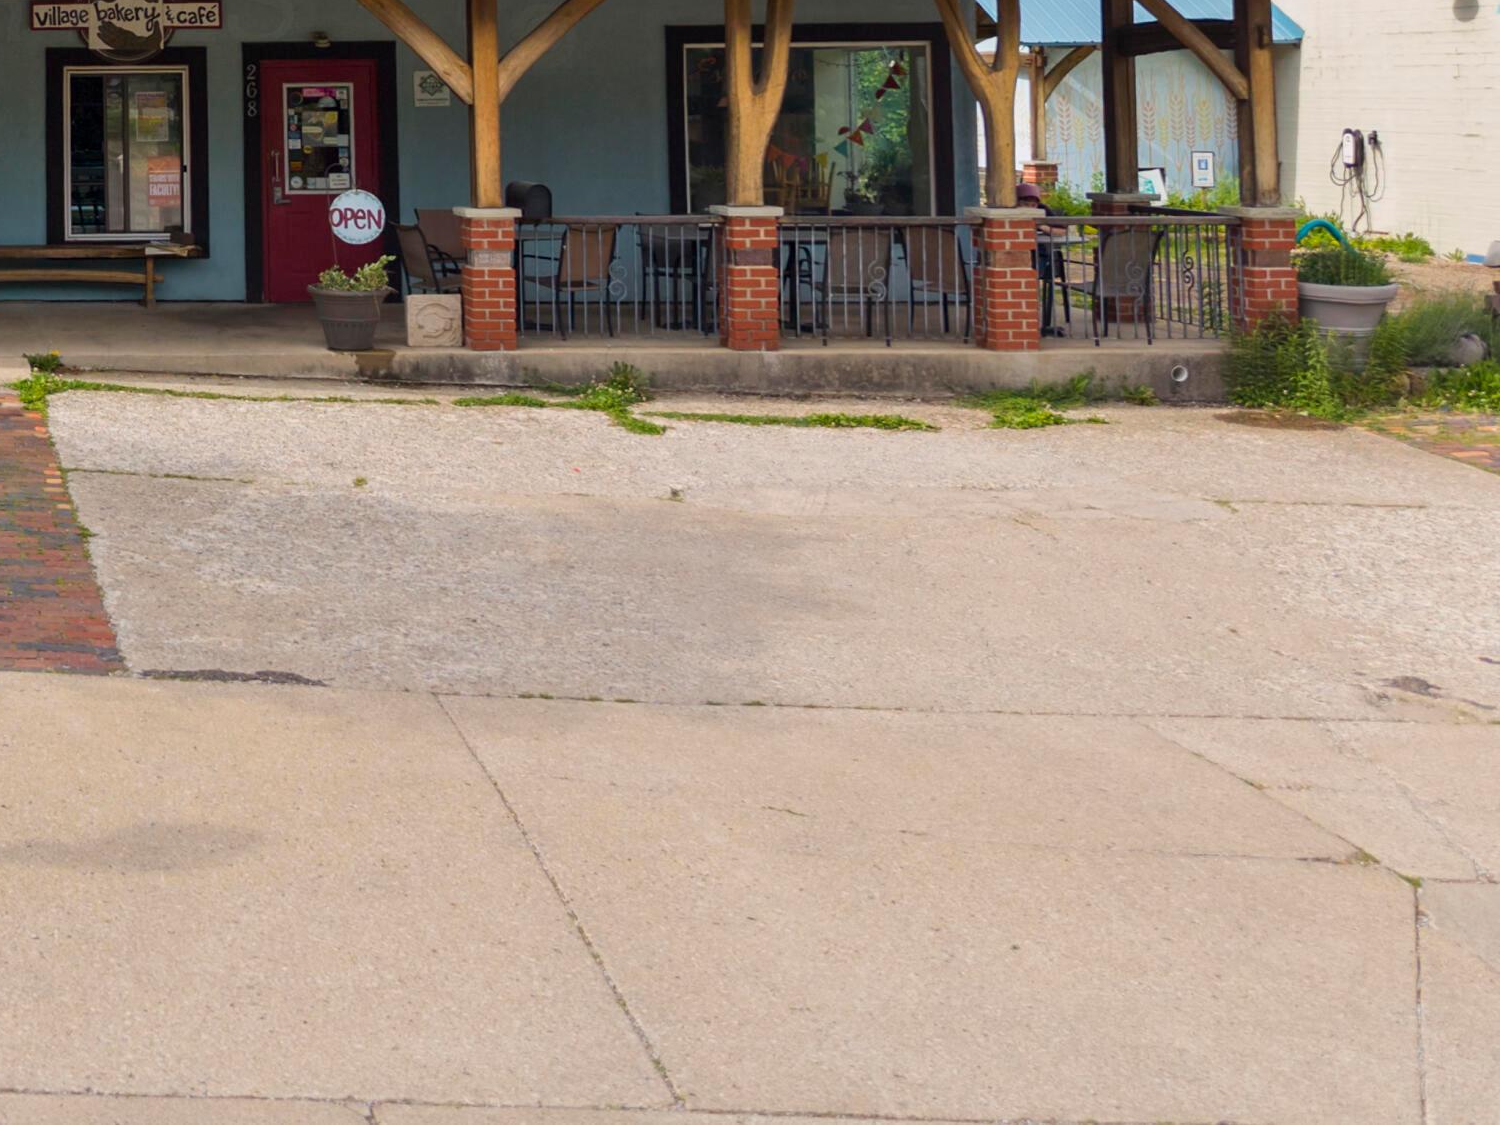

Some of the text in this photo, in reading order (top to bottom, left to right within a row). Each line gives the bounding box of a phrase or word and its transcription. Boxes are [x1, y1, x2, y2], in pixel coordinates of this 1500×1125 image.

[35, 6, 89, 26] village
[94, 2, 161, 32] bakery
[177, 5, 217, 25] café
[246, 64, 258, 117] 268
